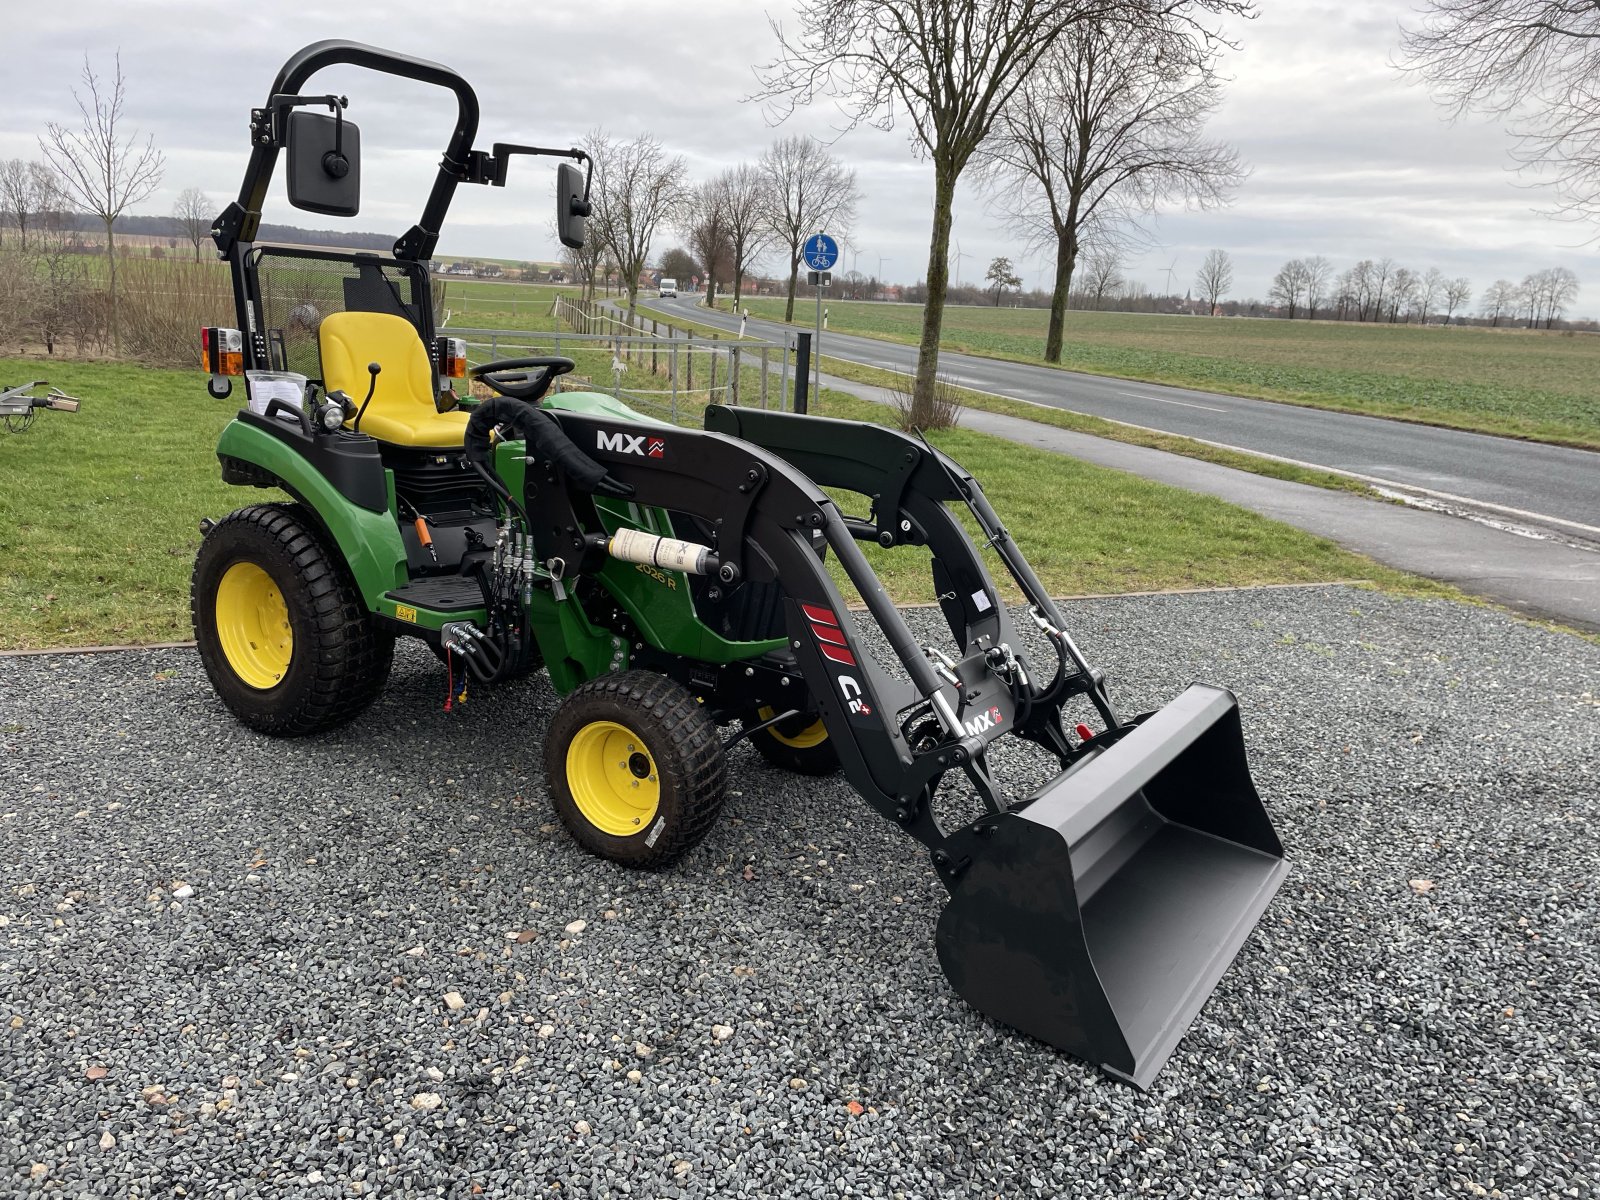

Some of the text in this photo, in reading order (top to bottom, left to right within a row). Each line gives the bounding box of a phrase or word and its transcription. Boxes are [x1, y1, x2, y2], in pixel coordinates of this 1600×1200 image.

[596, 430, 646, 456] MX
[635, 562, 676, 591] 2026 R
[964, 710, 995, 736] MX
